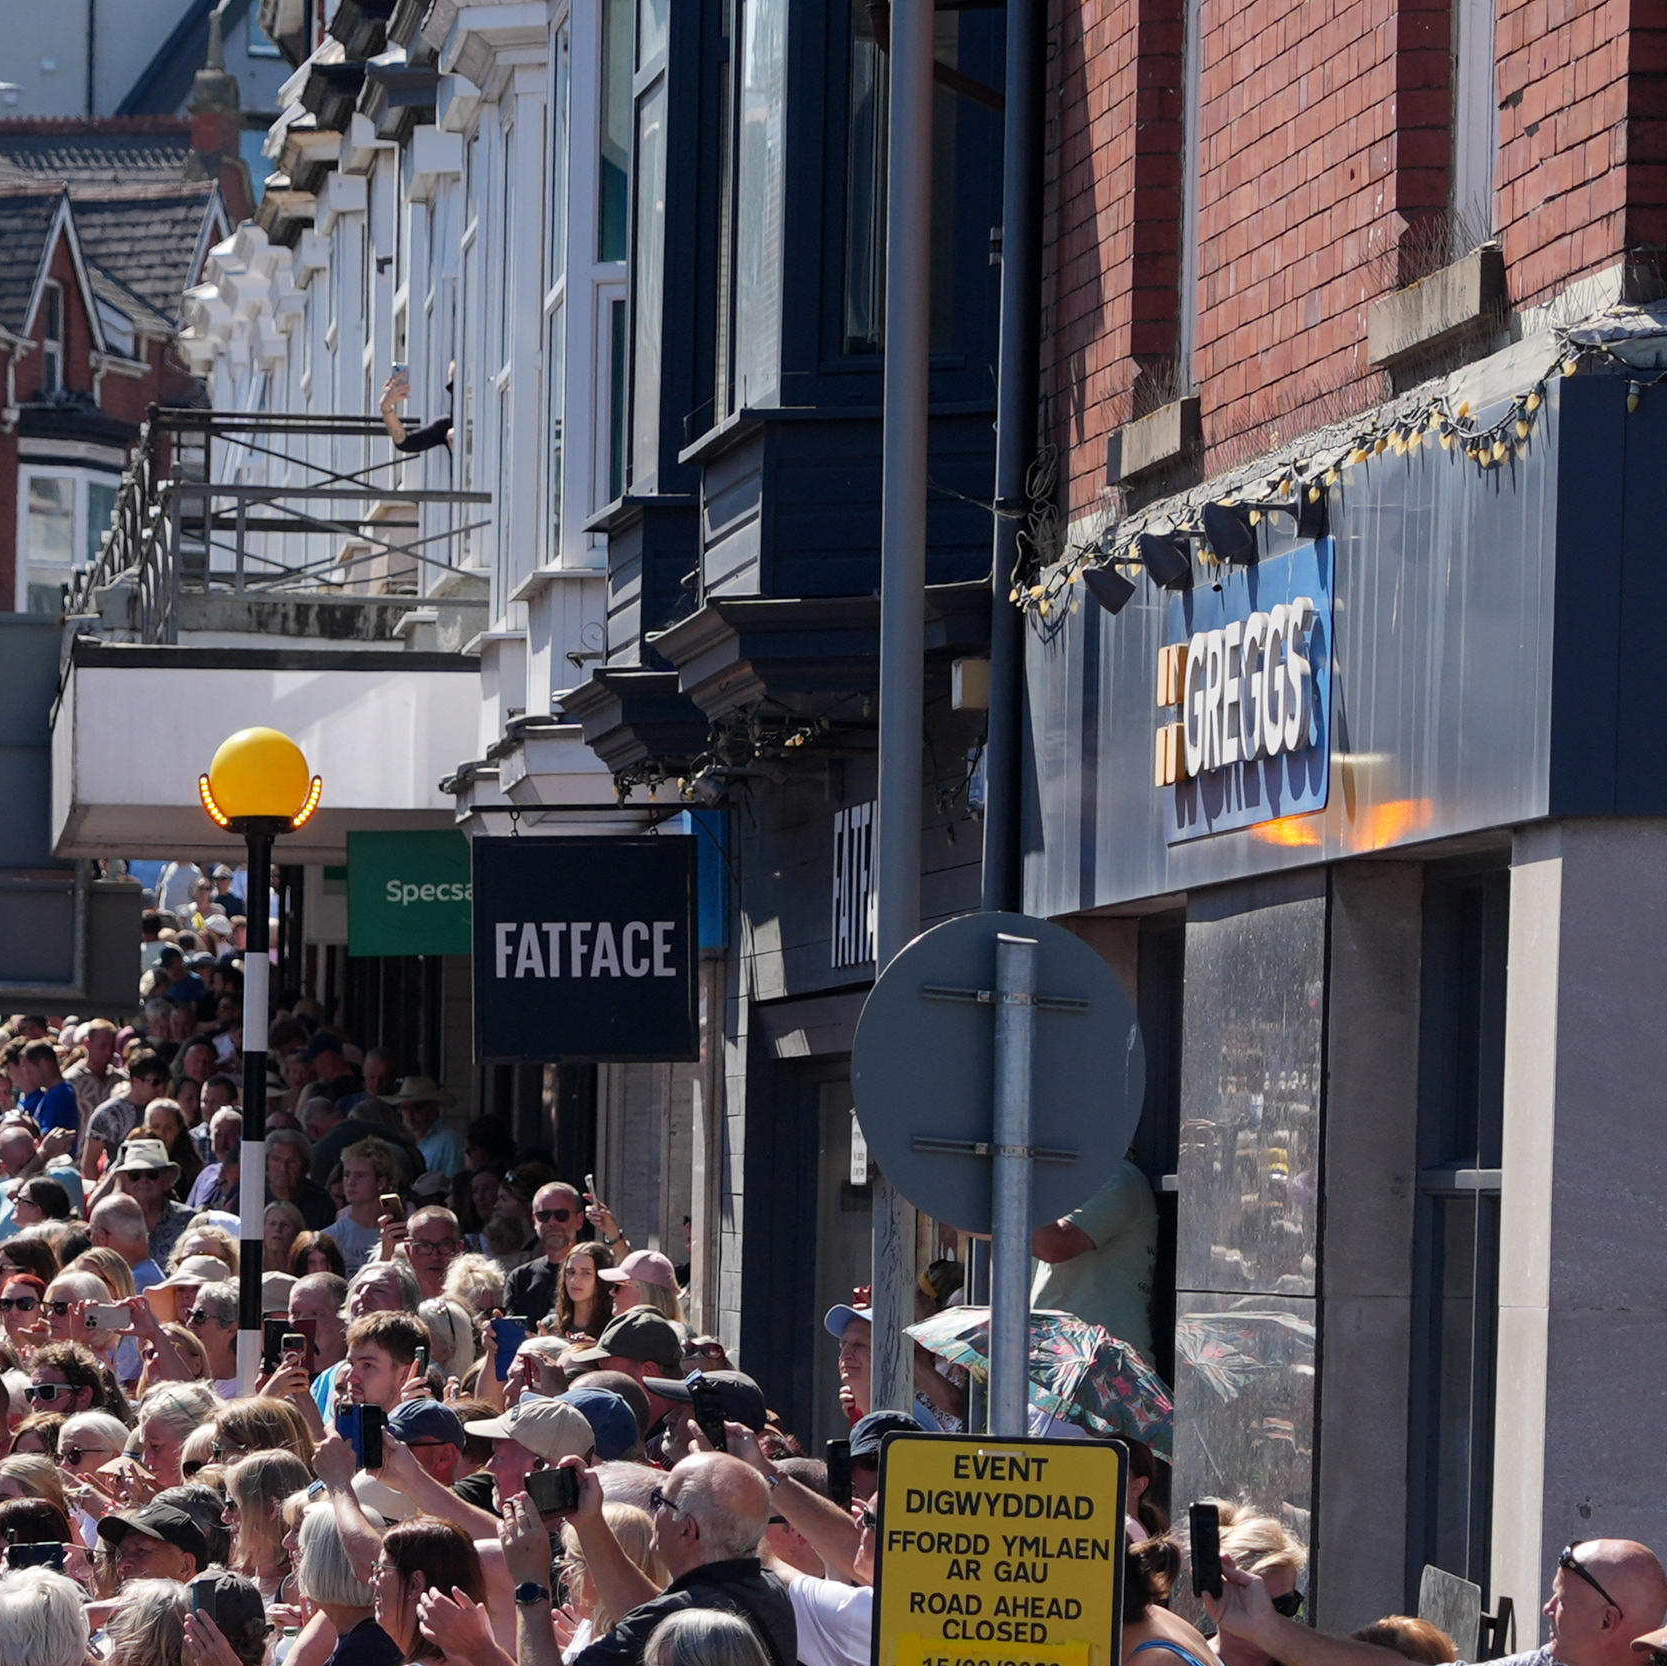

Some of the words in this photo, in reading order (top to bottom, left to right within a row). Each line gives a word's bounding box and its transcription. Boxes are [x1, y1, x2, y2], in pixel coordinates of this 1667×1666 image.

[1184, 597, 1314, 778] GREGGS
[495, 921, 677, 978] FATFACE
[954, 1454, 1049, 1482] EVENT
[906, 1489, 1094, 1520] DIGWYDDIAD
[888, 1530, 990, 1555] FFORDD
[1002, 1535, 1110, 1560] YMLAEN
[946, 1559, 981, 1581] AR
[994, 1561, 1049, 1583] GAU
[909, 1592, 982, 1615] ROAD
[994, 1596, 1082, 1620] AHEAD
[942, 1619, 1047, 1644] CLOSED
